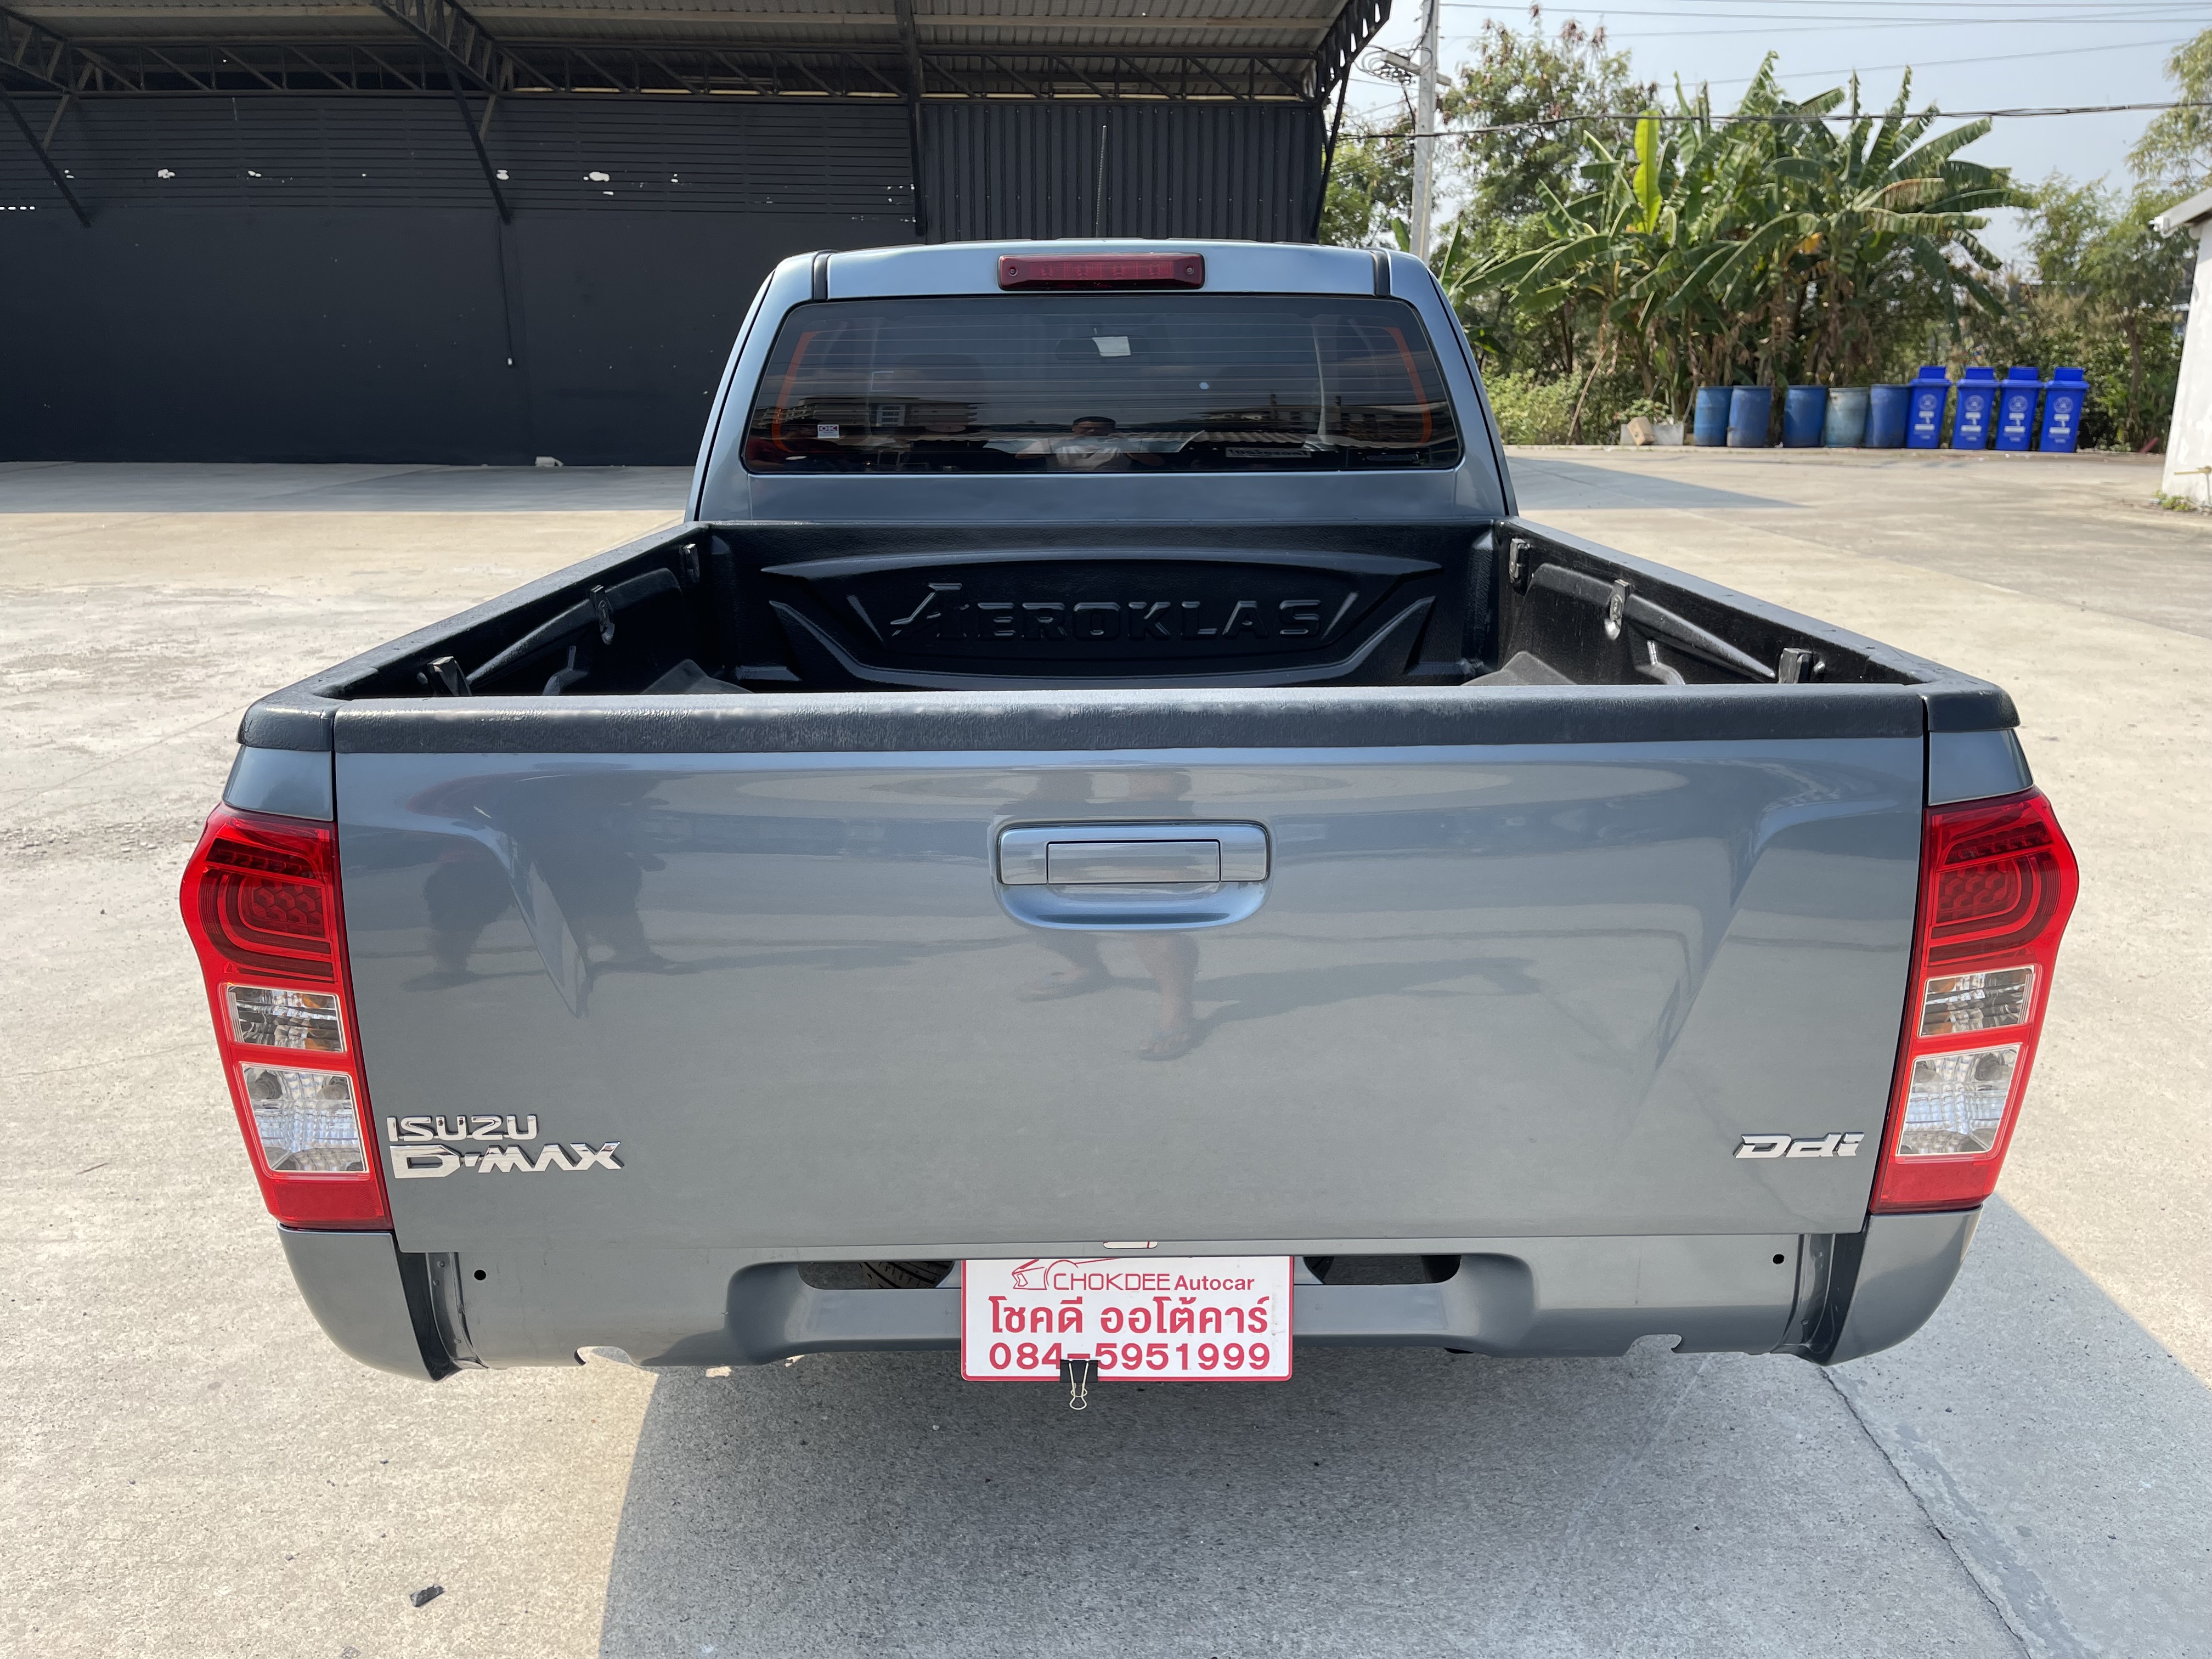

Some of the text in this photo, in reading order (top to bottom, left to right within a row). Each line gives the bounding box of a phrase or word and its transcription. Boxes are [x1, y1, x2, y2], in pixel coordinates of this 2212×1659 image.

[889, 582, 1322, 641] AEROKLAS
[387, 1114, 539, 1142] ISUZU
[1733, 1131, 1865, 1159] Ddi
[390, 1141, 625, 1179] D-MAX
[1053, 1272, 1255, 1291] CHOKDEE Autocar
[988, 1295, 1270, 1334] โชคดี ออโต้คาร์
[989, 1342, 1271, 1371] 084-5951999
